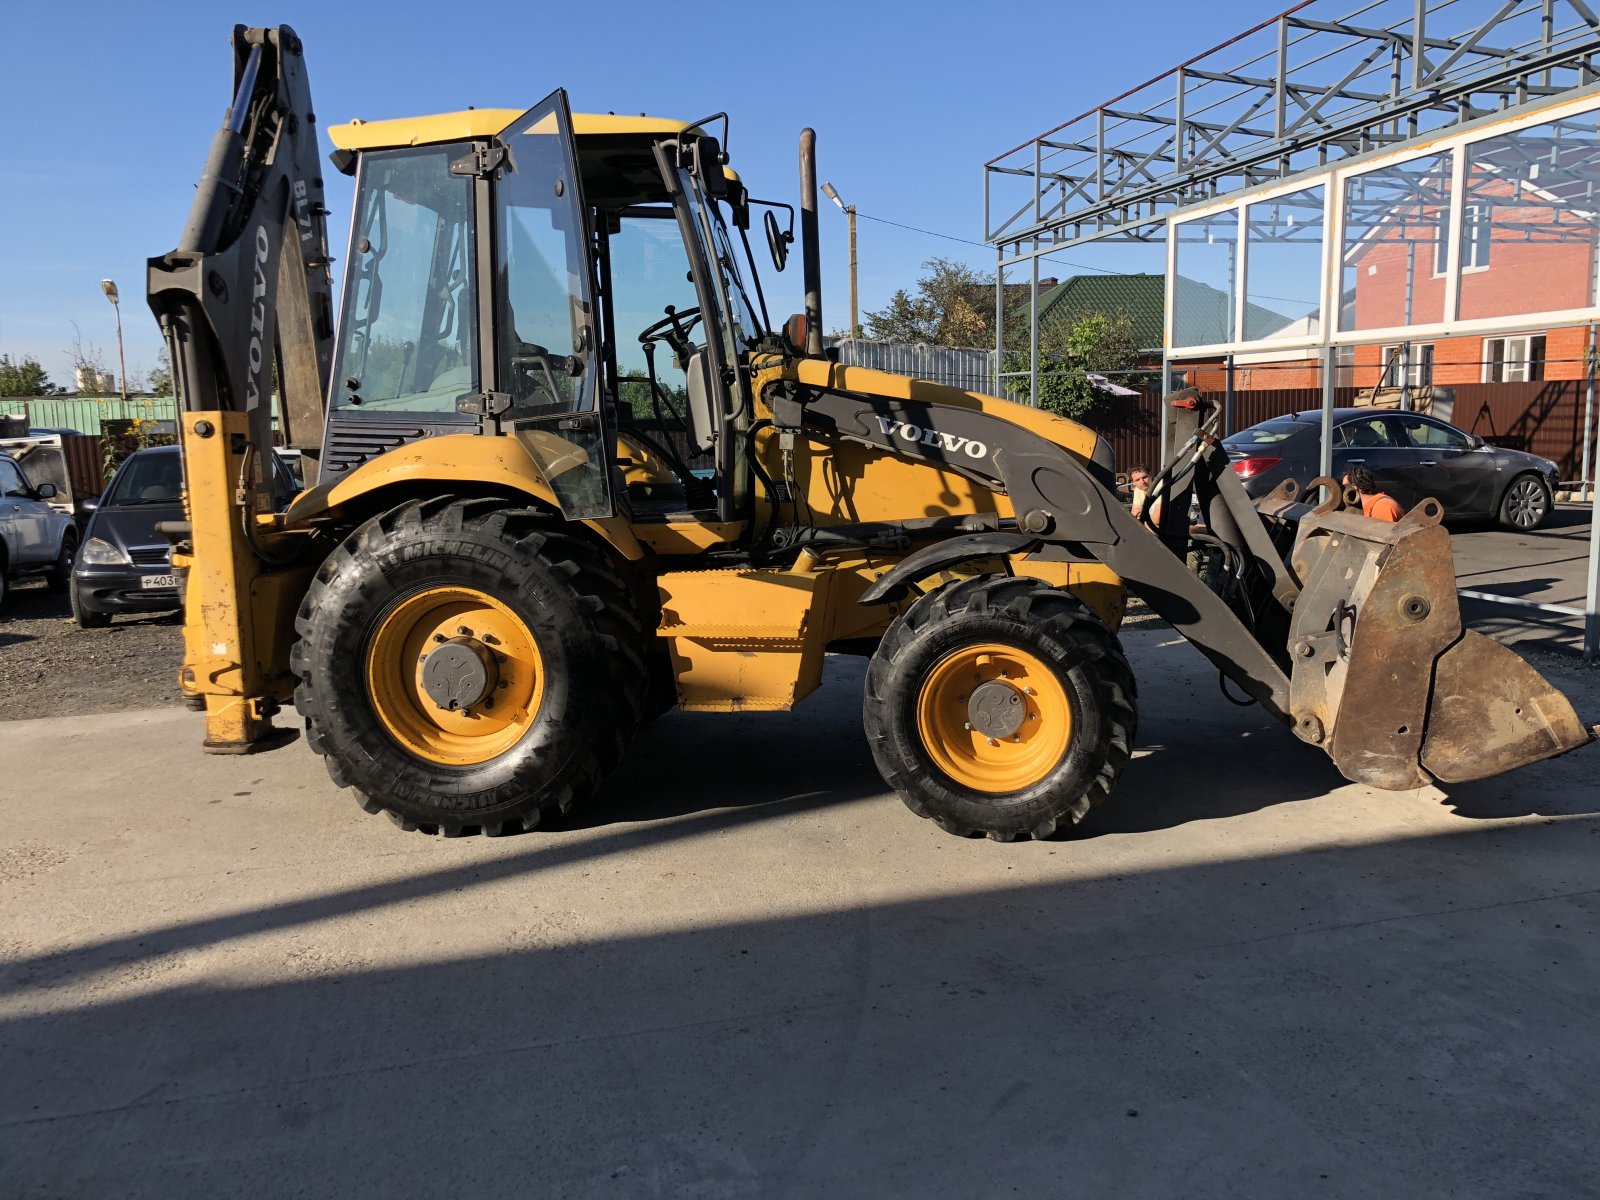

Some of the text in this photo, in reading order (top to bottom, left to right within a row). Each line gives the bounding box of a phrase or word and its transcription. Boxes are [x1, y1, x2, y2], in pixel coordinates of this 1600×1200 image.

[293, 180, 313, 242] BL71
[246, 225, 269, 413] VOLVO
[874, 415, 987, 459] VOLVO
[403, 541, 512, 574] MICHELIN
